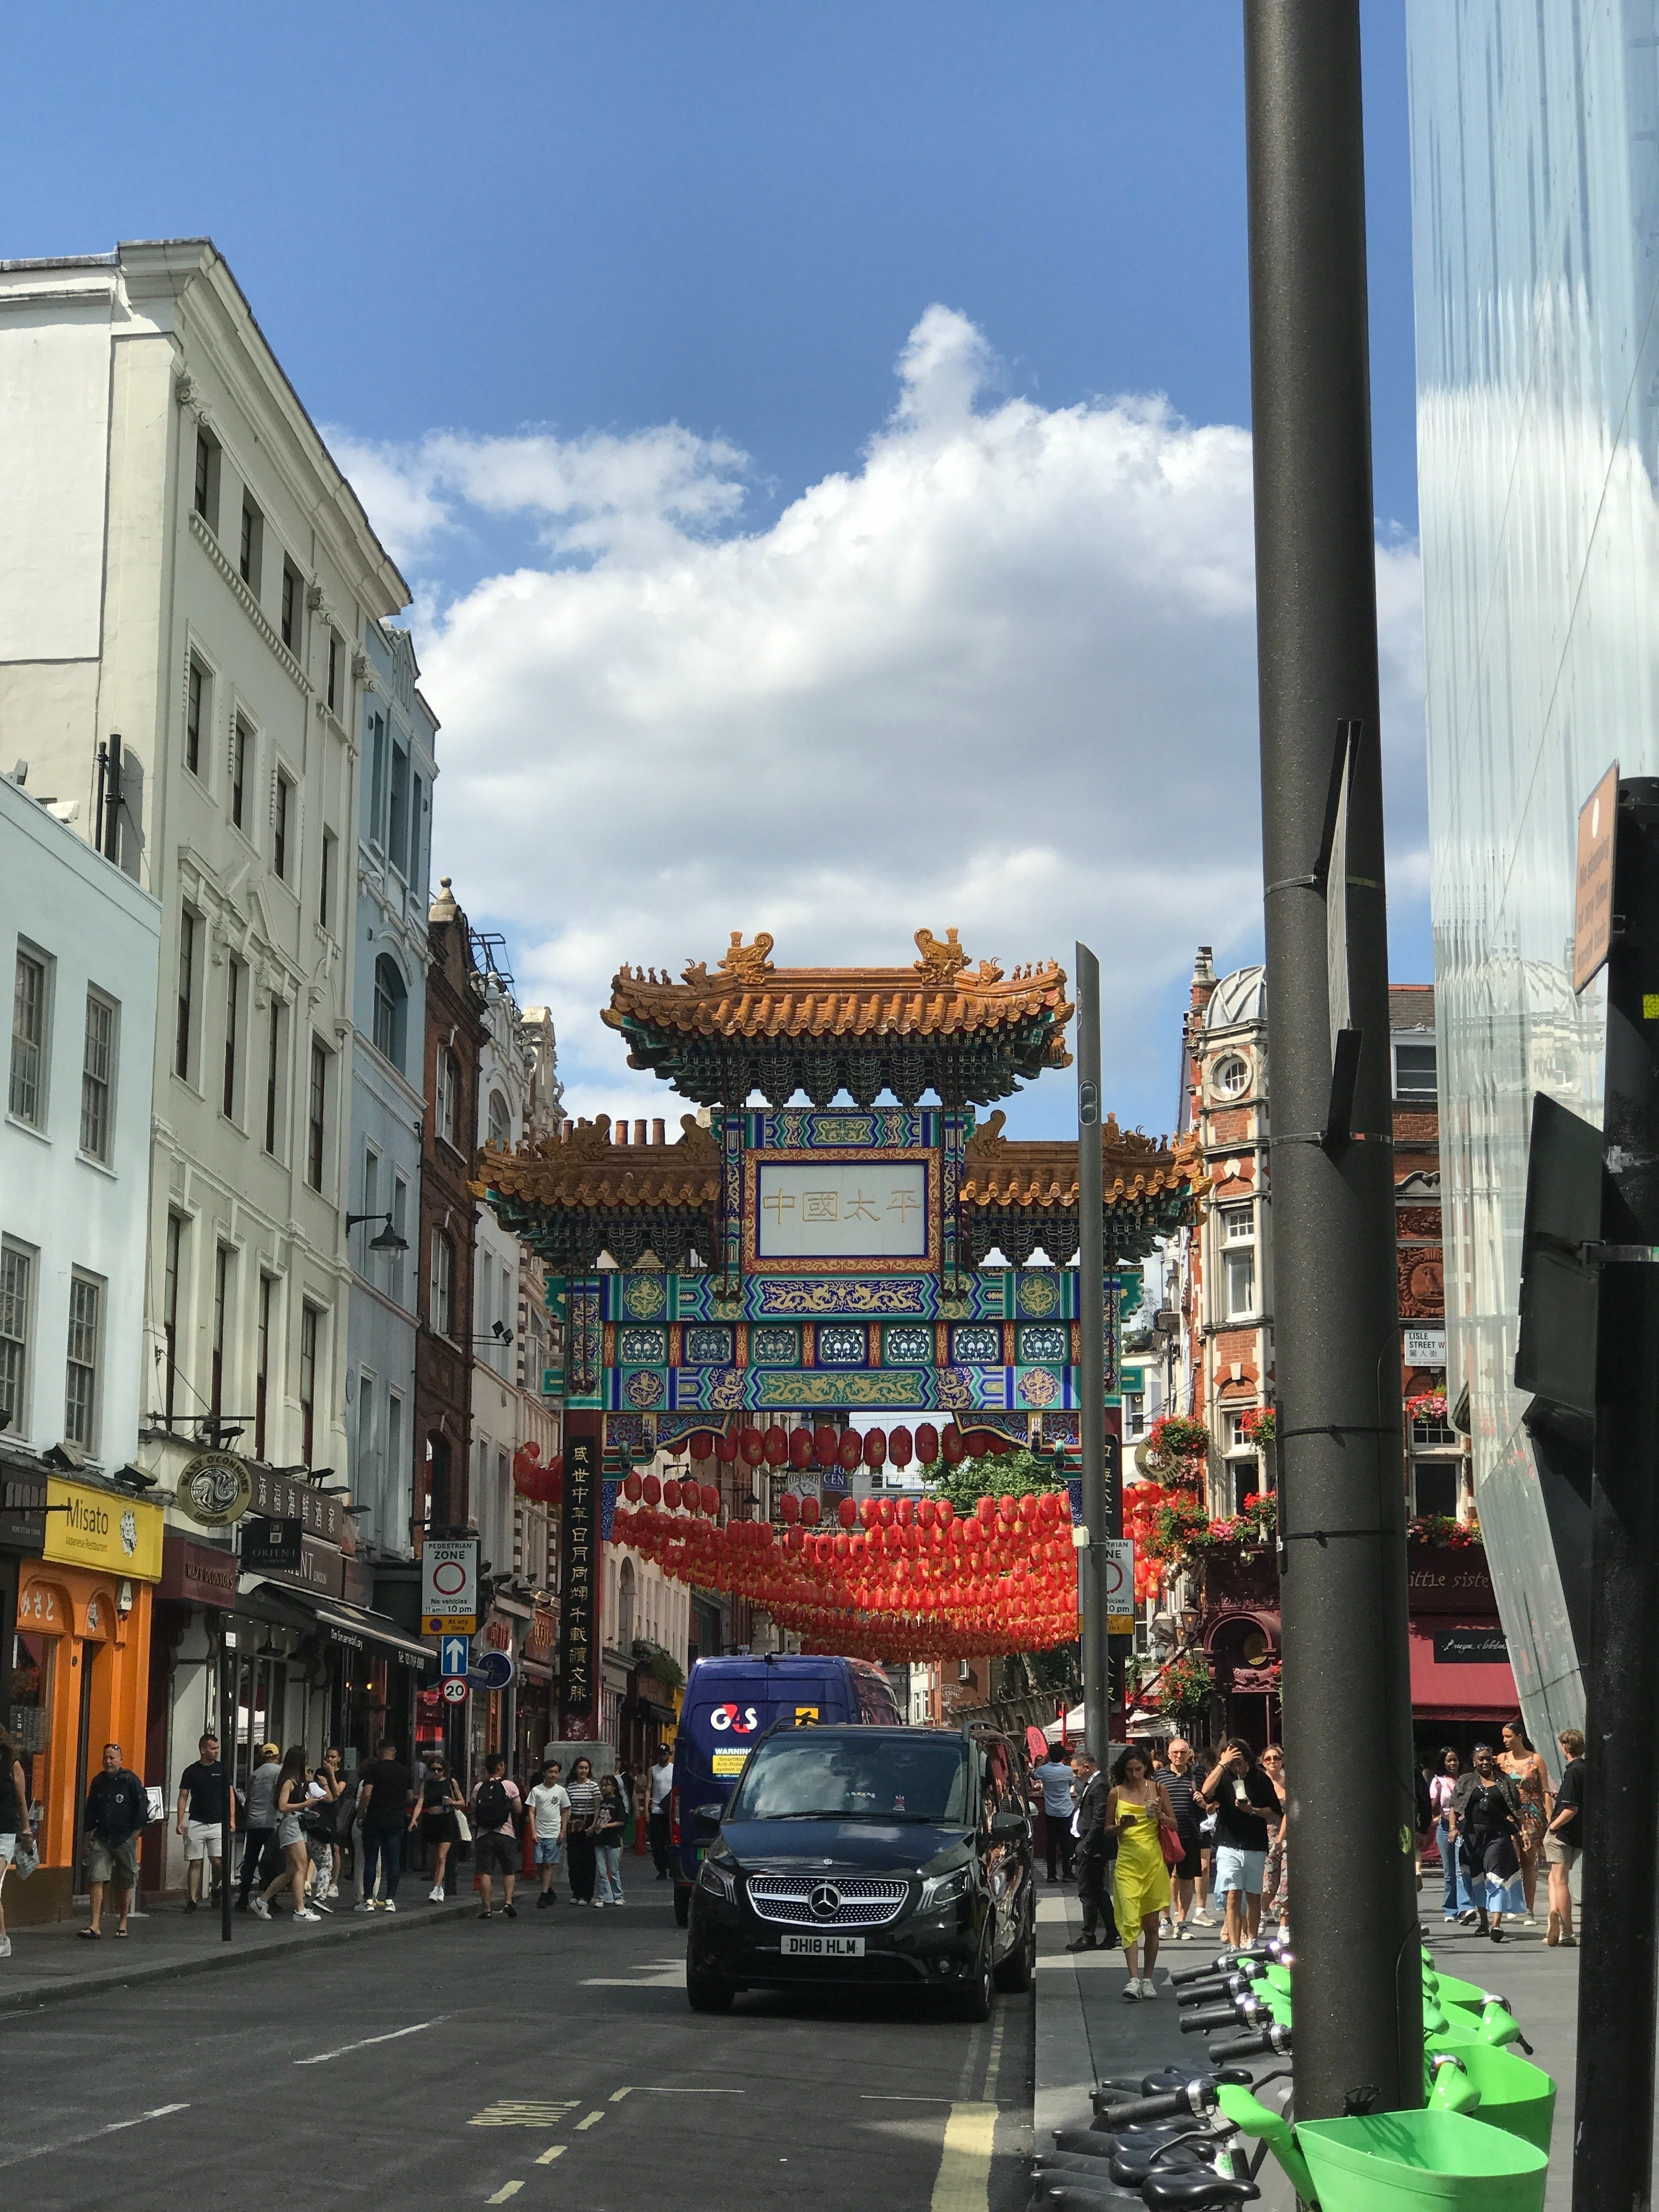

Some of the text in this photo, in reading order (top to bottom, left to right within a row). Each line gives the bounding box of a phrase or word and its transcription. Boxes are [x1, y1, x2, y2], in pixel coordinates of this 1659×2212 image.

[763, 1188, 922, 1226] 中國太平
[181, 1459, 203, 1486] WAXY
[66, 1496, 109, 1535] Misato
[194, 1511, 227, 1523] LONDON
[65, 1536, 108, 1553] Japanese Restaurant
[434, 1550, 465, 1560] ZONE
[1452, 1571, 1489, 1588] siste
[446, 1685, 465, 1697] 20
[710, 1704, 758, 1733] G4S
[789, 1938, 856, 1954] DH18 HLM
